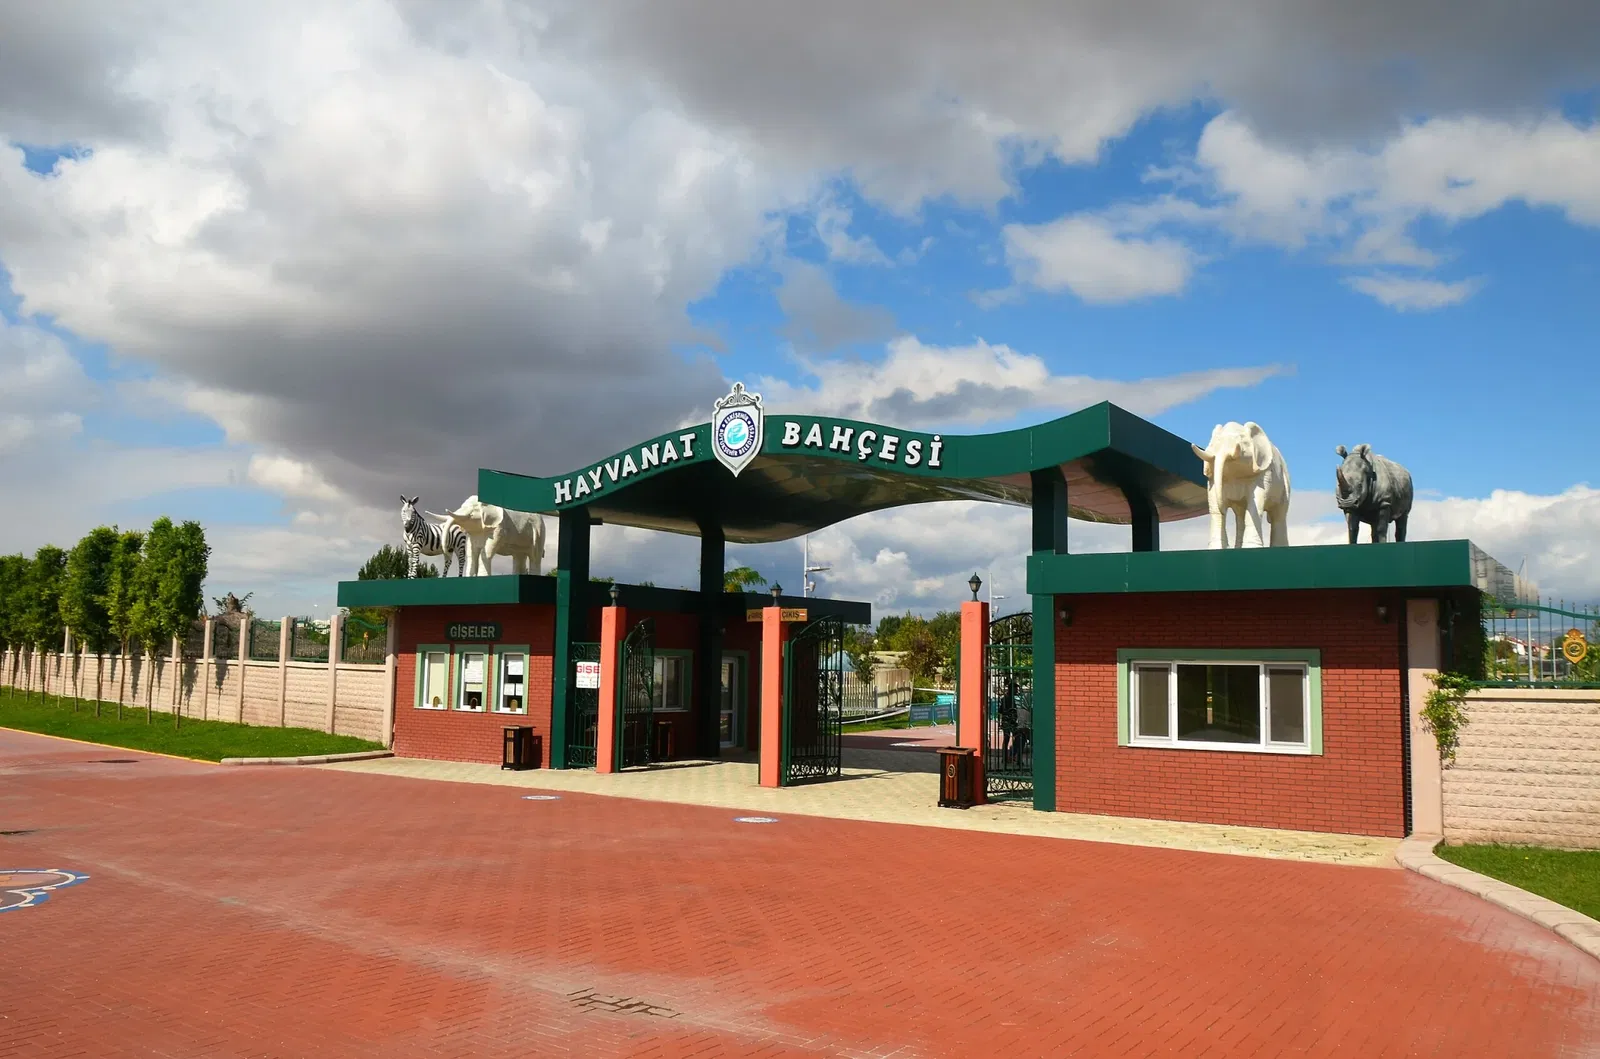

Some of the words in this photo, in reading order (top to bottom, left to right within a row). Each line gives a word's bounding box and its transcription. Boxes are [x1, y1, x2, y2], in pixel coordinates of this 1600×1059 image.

[554, 432, 696, 503] HAYVANAT
[782, 421, 943, 467] BAHÇESİ
[450, 624, 496, 640] GİŞELER
